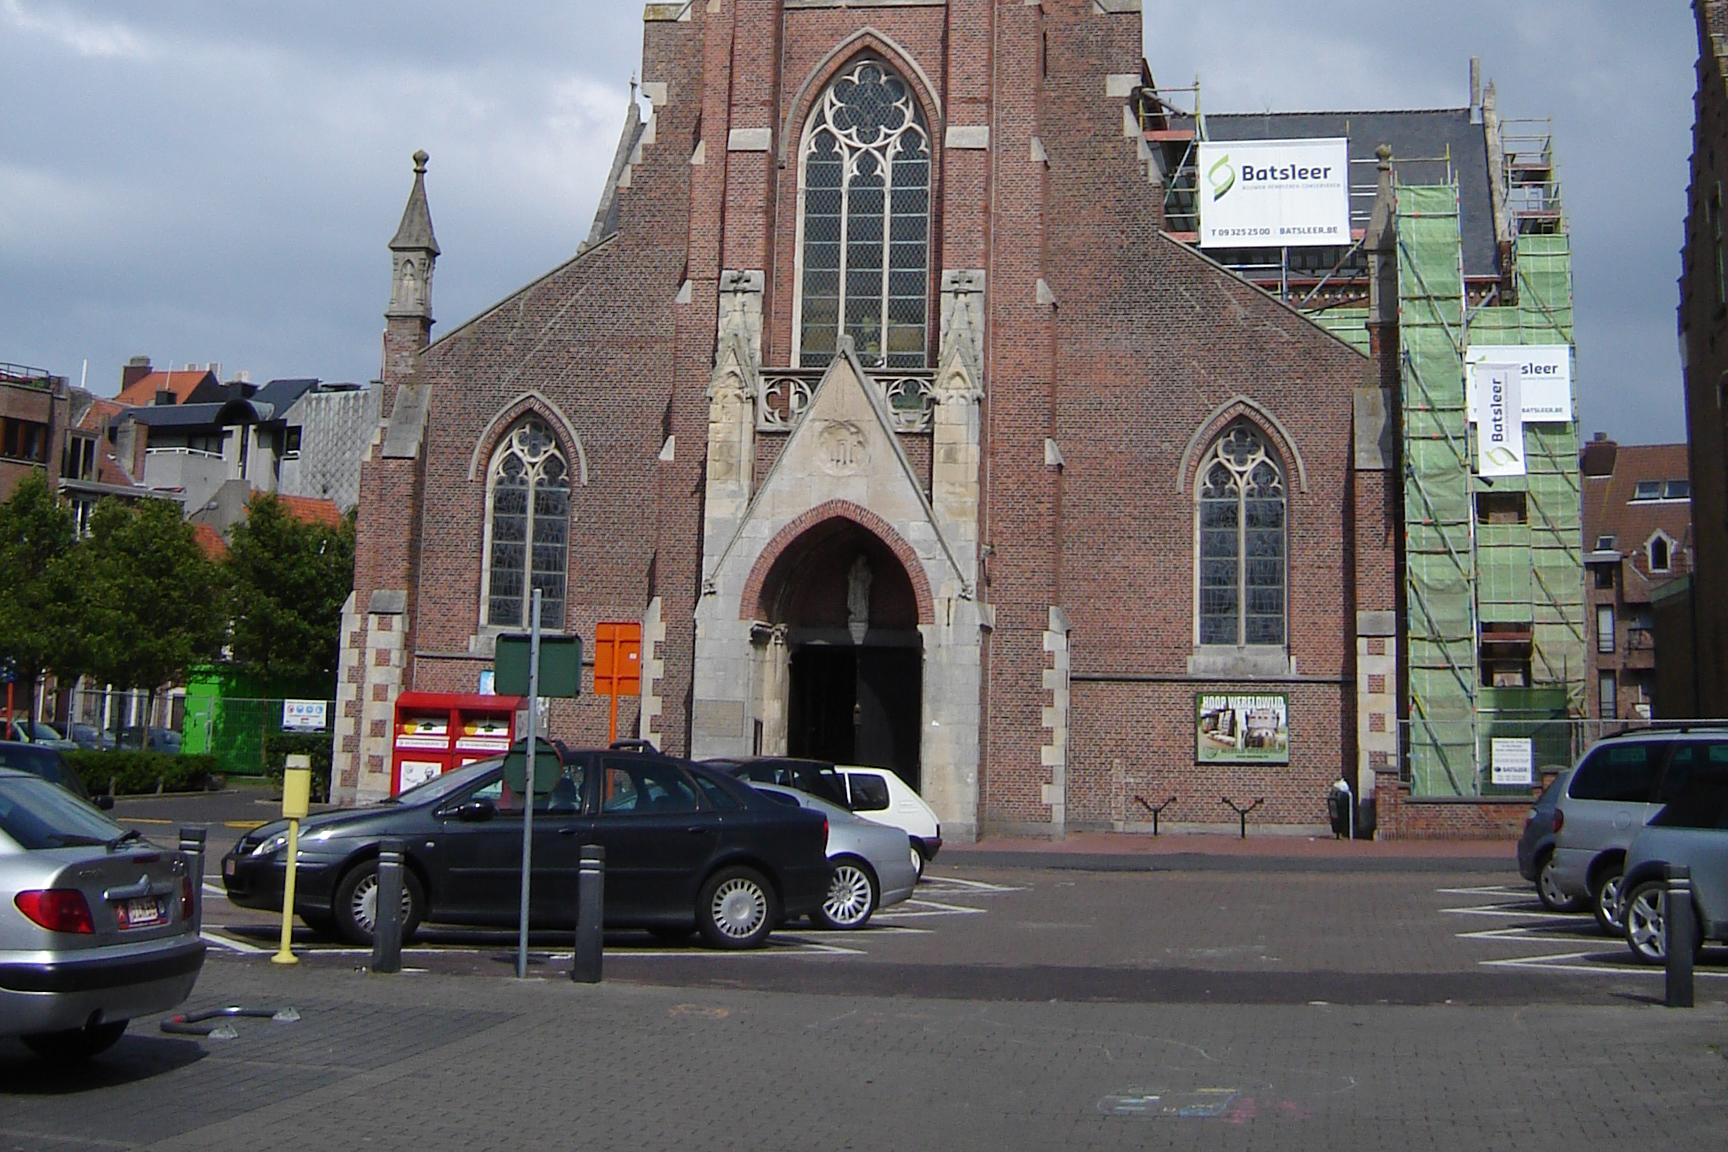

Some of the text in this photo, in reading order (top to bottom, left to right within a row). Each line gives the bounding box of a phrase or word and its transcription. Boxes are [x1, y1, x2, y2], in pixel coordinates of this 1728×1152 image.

[1242, 164, 1332, 181] Batsleer
[1279, 226, 1338, 235] BATSLEER.BE
[1521, 362, 1559, 375] sleer
[1490, 378, 1503, 442] Batsleer
[1202, 695, 1226, 709] HOOP
